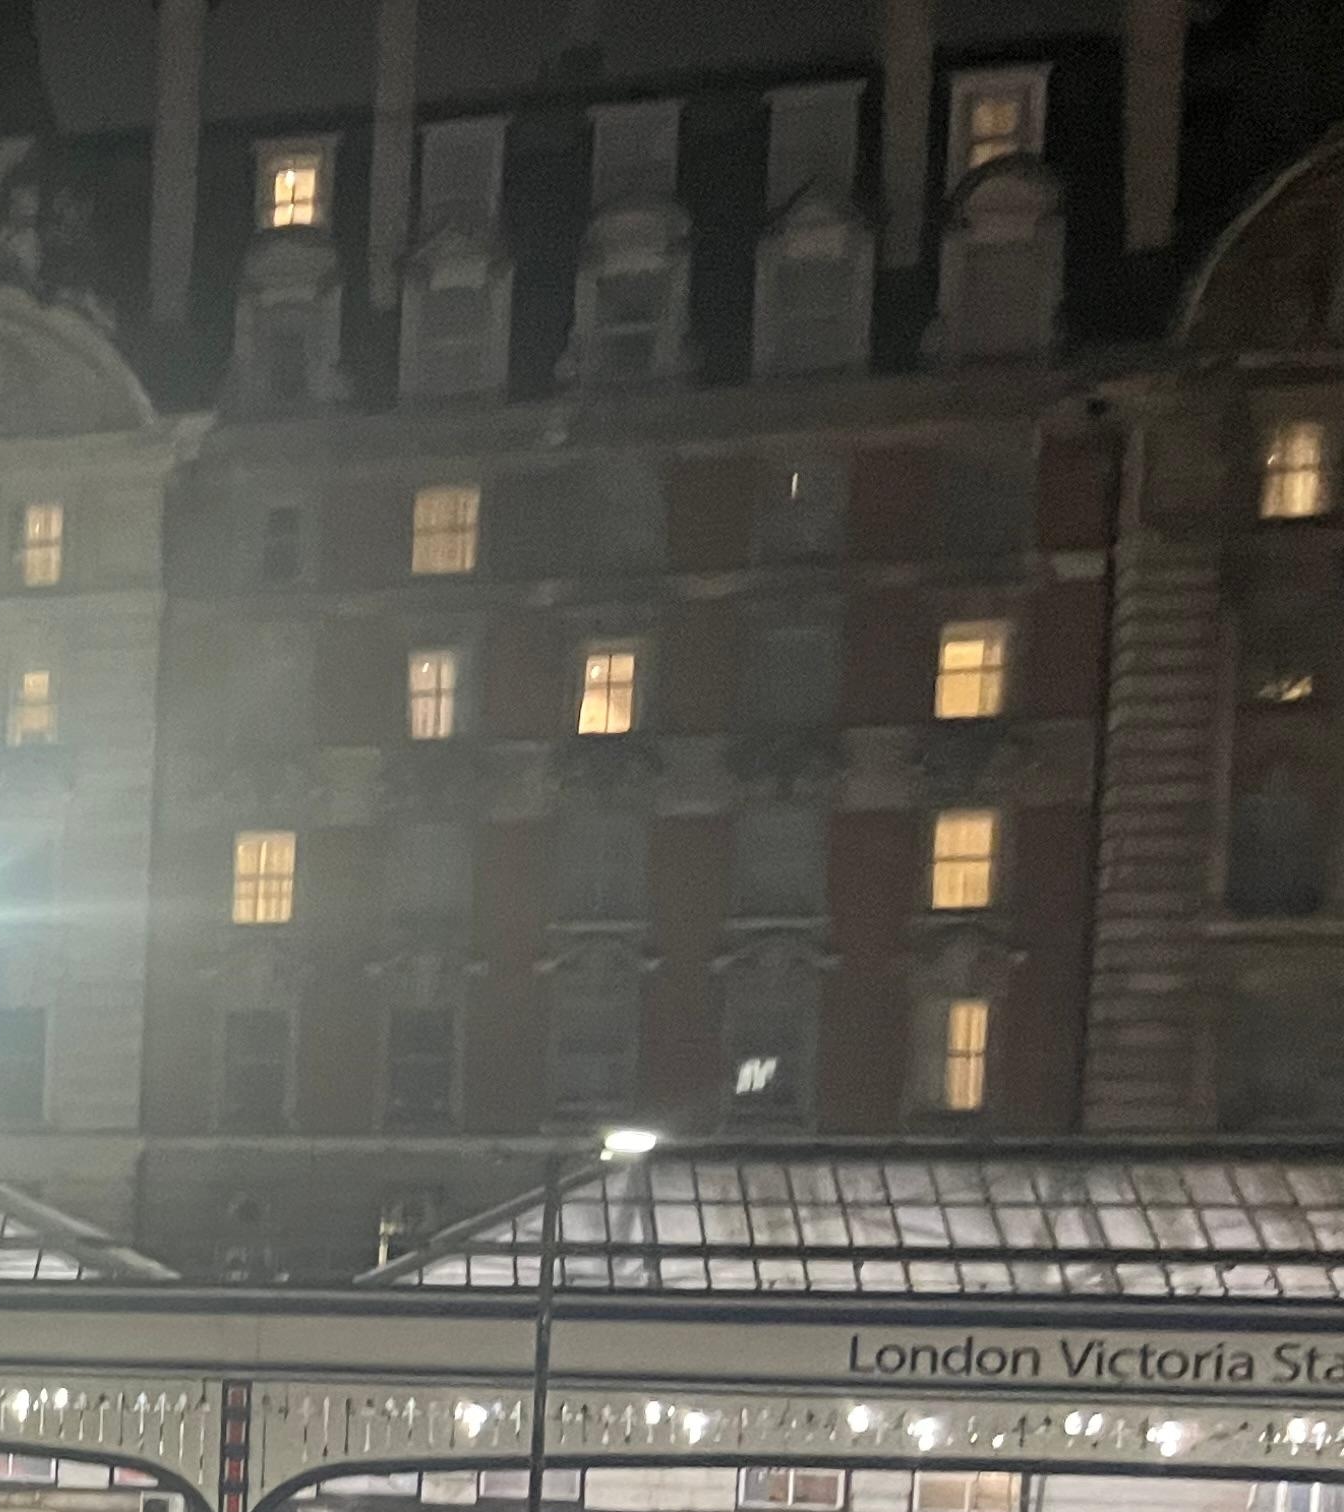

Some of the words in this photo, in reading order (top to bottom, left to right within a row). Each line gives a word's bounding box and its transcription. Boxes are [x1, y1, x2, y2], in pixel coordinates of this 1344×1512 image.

[849, 1335, 1041, 1377] London
[1060, 1338, 1255, 1381] Victoria
[1272, 1343, 1344, 1385] Sta
